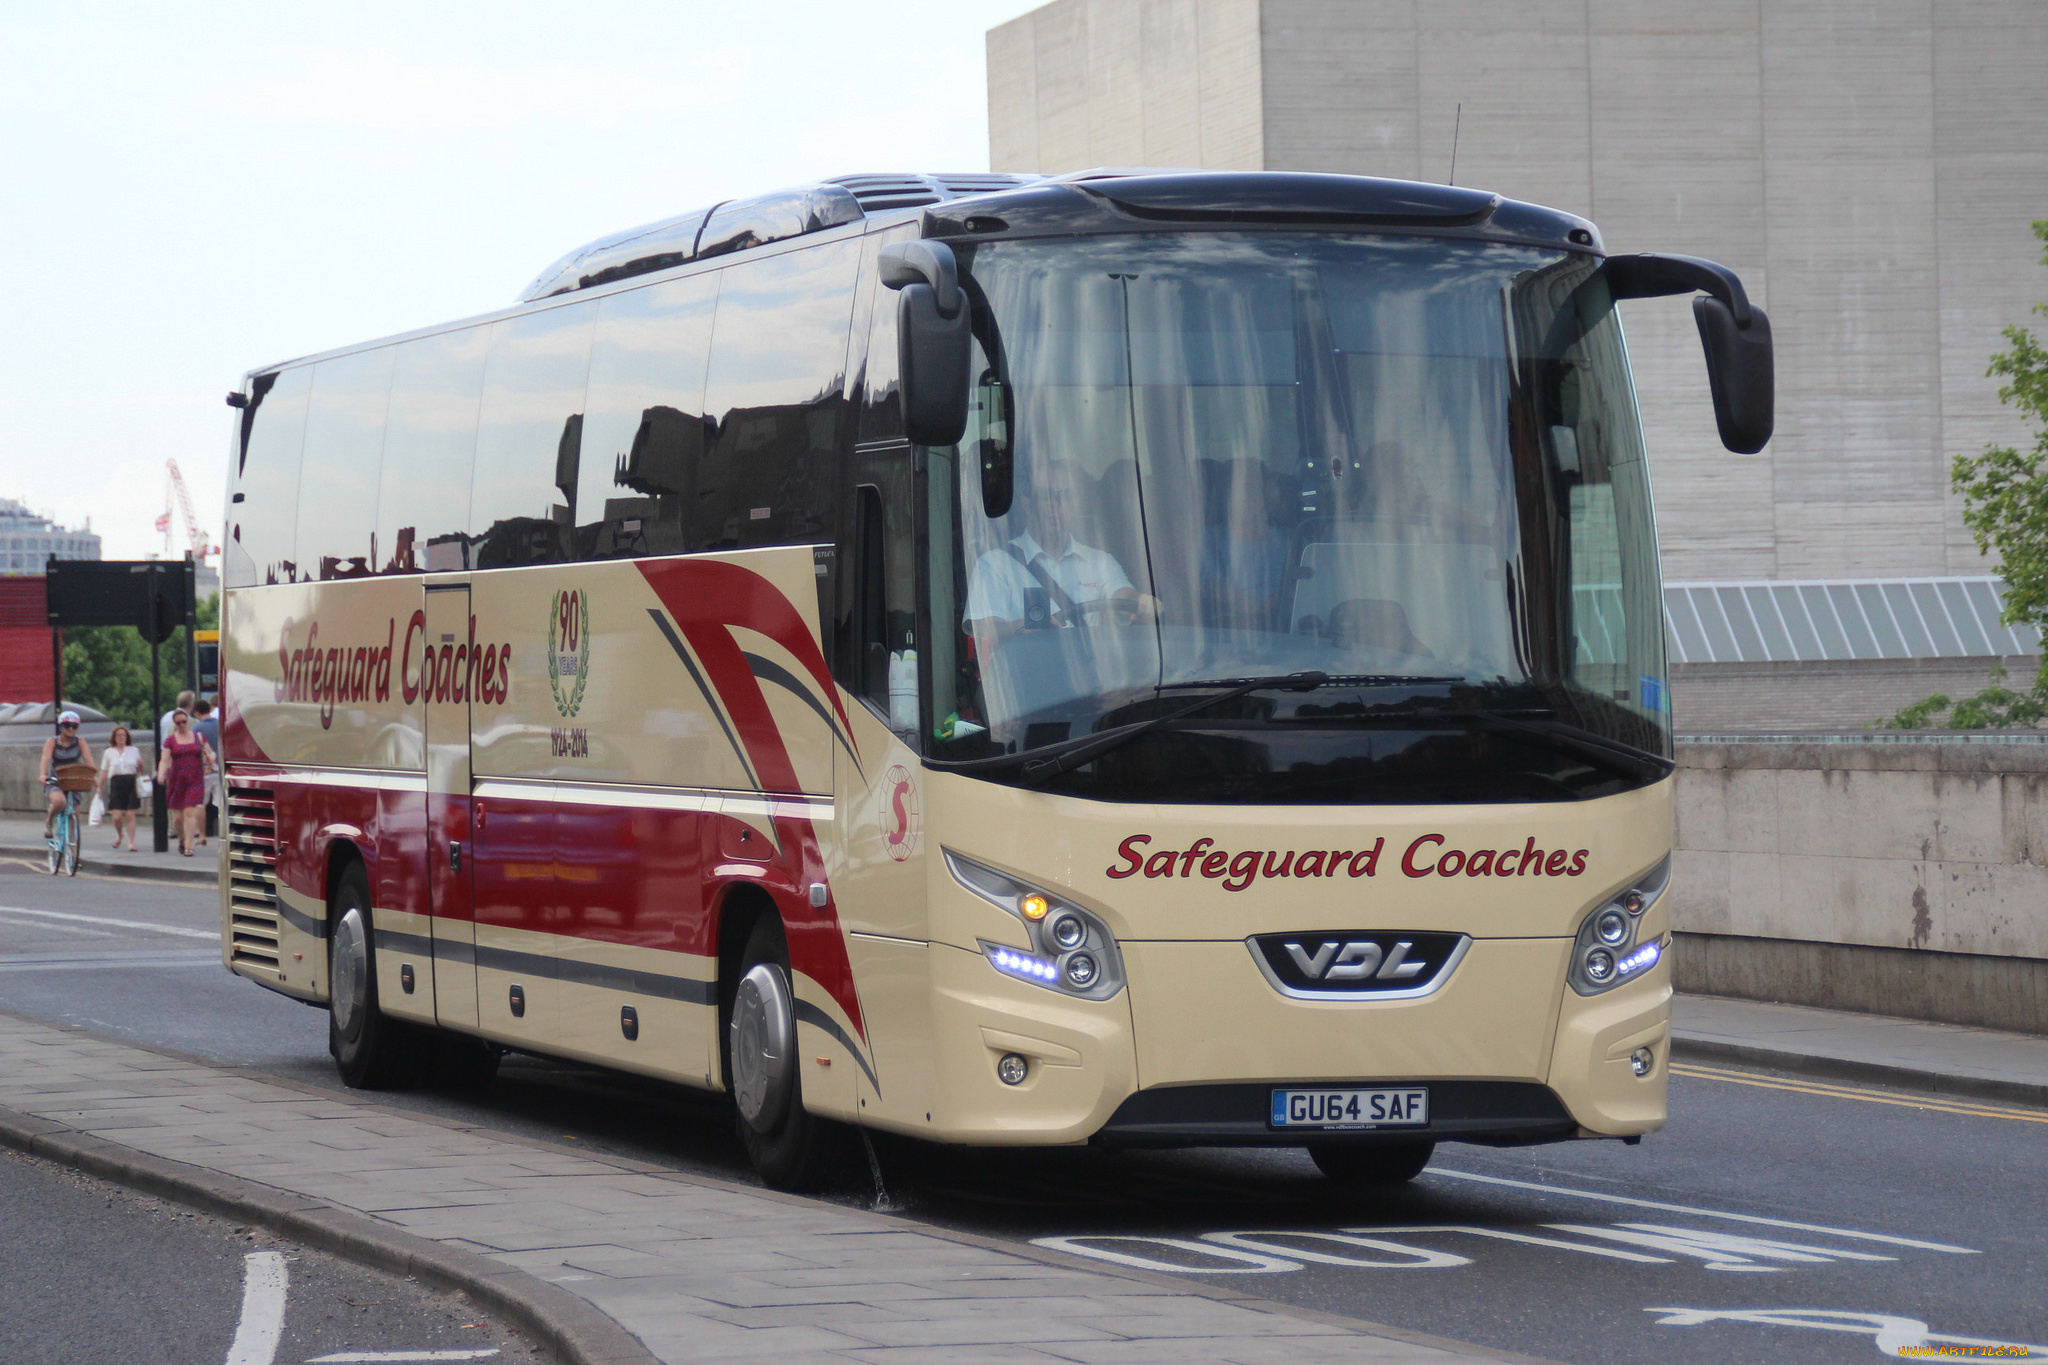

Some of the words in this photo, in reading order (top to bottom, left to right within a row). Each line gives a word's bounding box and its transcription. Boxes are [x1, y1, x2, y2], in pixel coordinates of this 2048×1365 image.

[559, 590, 579, 652] 90
[274, 616, 395, 730] Safeguard
[401, 609, 511, 705] Coaches
[551, 727, 588, 758] 1924-2014
[888, 781, 909, 845] S
[1106, 834, 1385, 892] Safeguard
[1401, 833, 1589, 878] Coaches
[1283, 942, 1427, 980] VDL
[1290, 1095, 1361, 1121] GU64
[1370, 1093, 1423, 1120] SAF
